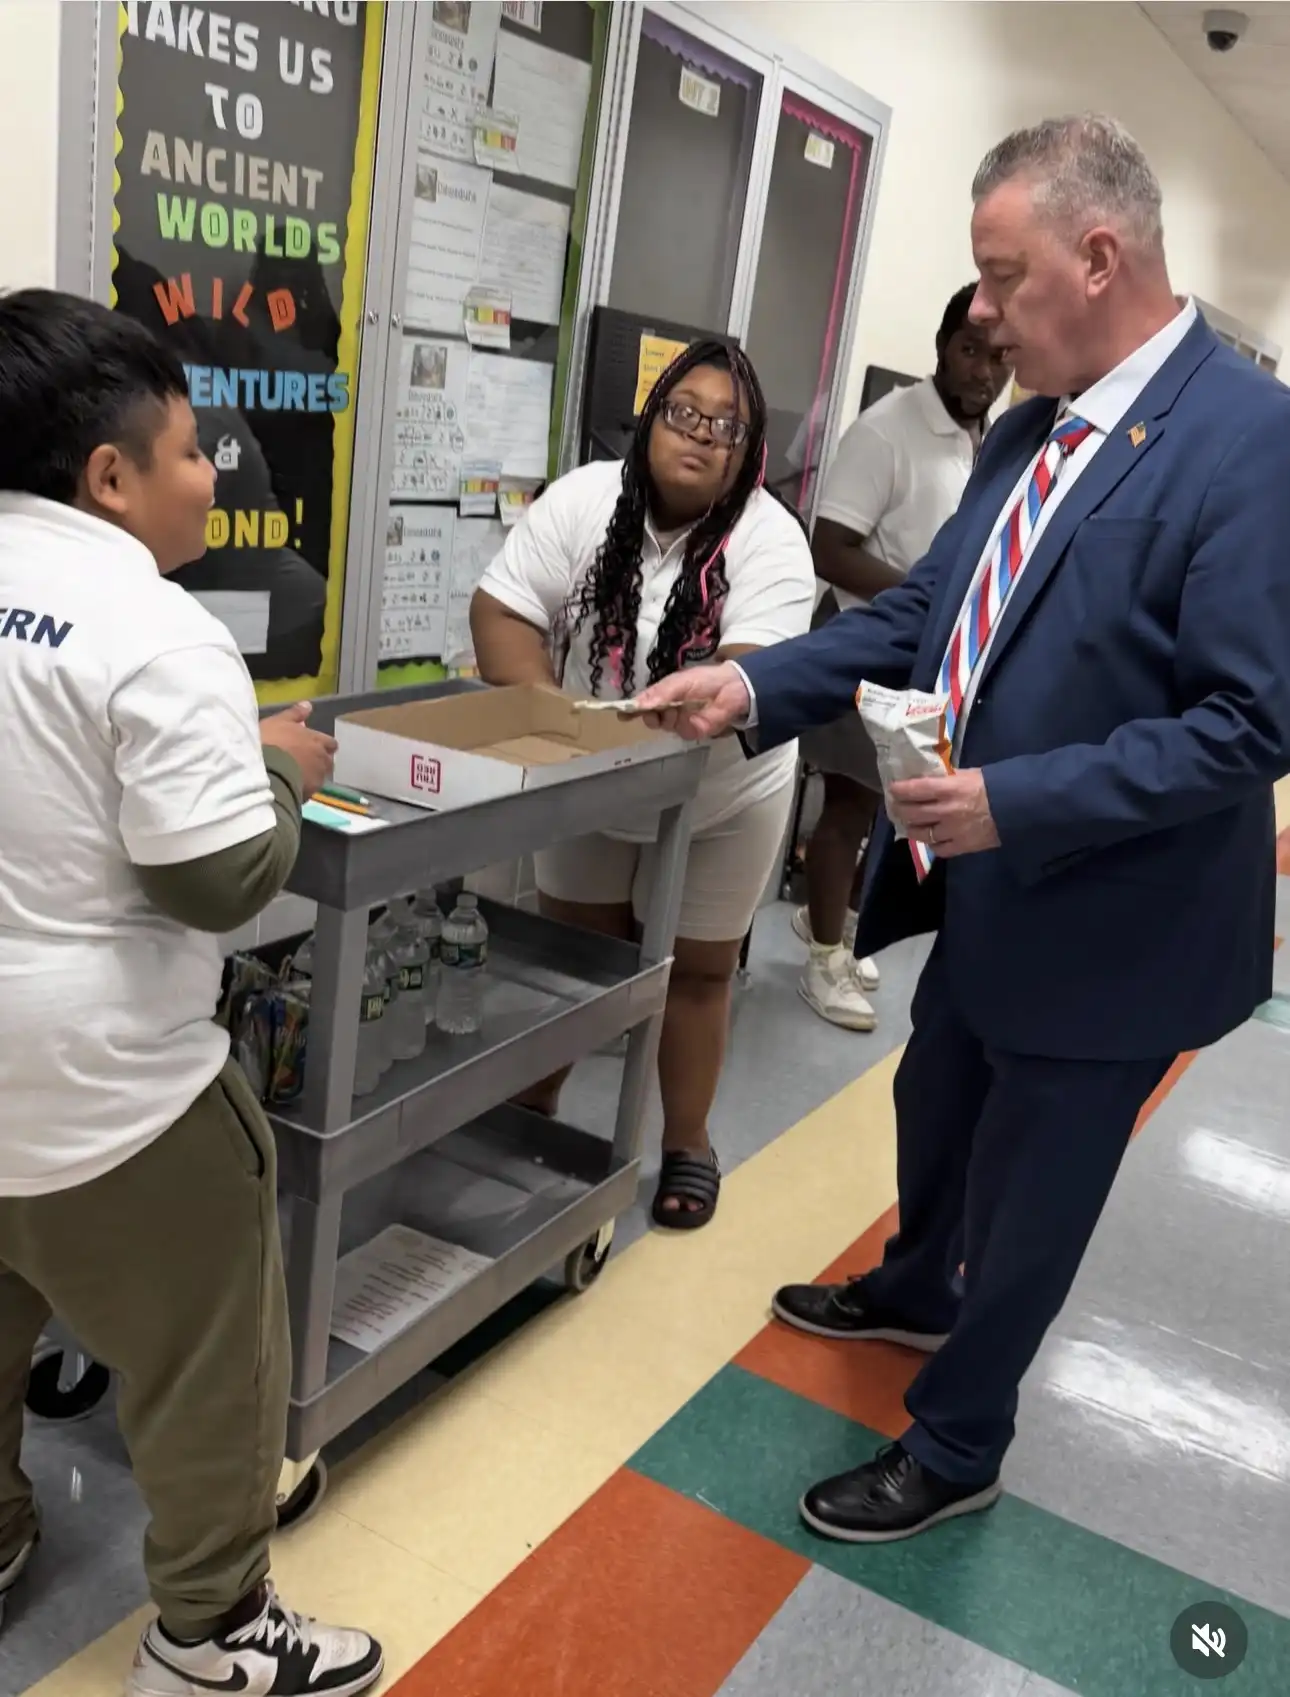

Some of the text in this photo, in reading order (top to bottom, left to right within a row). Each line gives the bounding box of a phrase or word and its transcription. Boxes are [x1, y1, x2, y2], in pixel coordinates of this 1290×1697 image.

[127, 1, 334, 94] TAKES US
[205, 82, 263, 139] TO
[140, 130, 324, 210] ANCIENT
[157, 193, 340, 265] WORLDS
[153, 273, 296, 333] WILD
[214, 434, 241, 470] &
